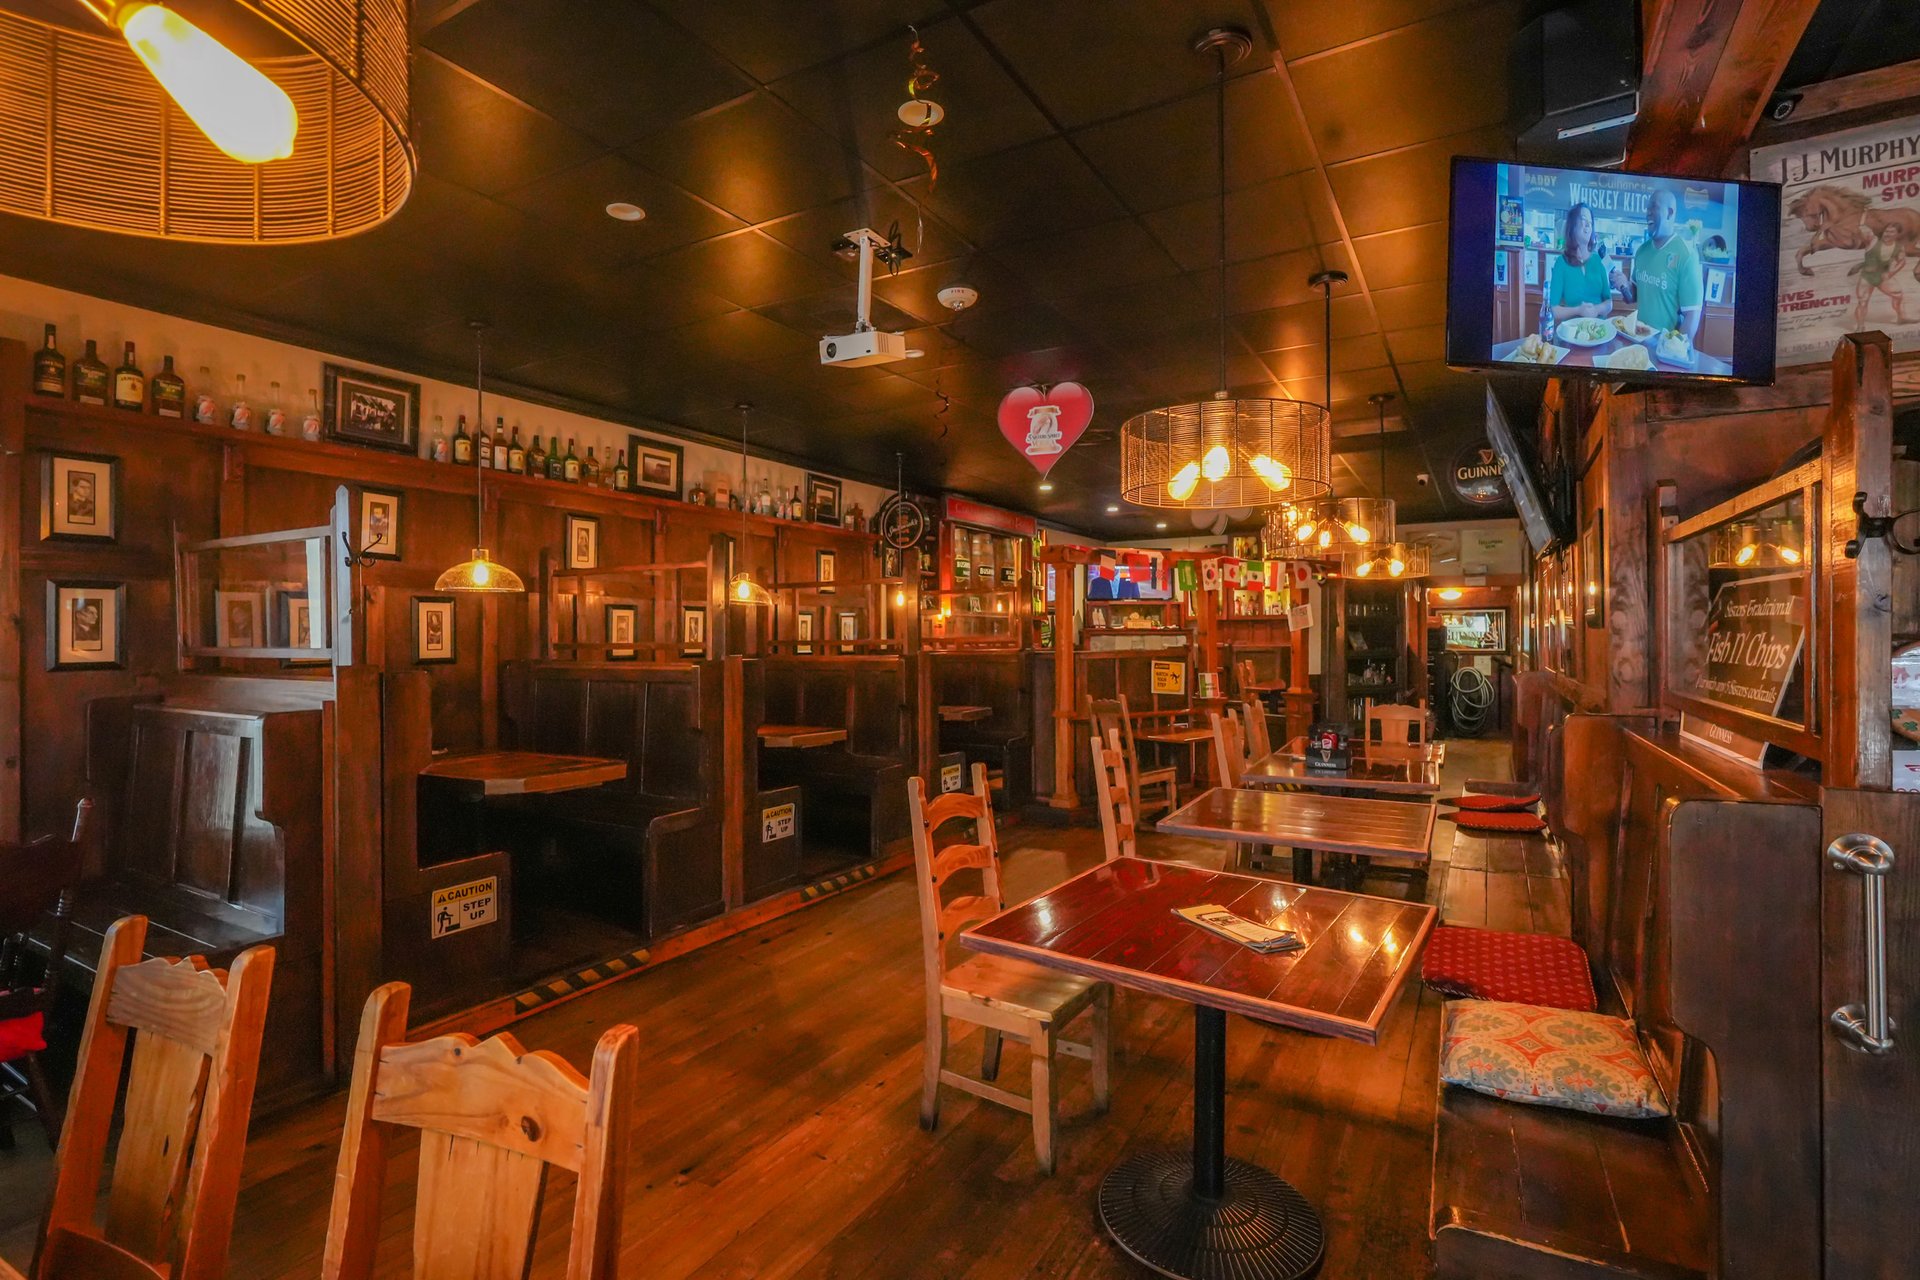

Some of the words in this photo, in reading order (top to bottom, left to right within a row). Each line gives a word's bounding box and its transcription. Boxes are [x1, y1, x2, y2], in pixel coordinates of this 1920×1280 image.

[1820, 134, 1920, 175] MURPHY
[1525, 173, 1557, 187] PADDY
[1569, 182, 1619, 212] WHISKEY
[1623, 192, 1651, 214] KITC
[1881, 182, 1920, 203] STO
[1705, 631, 1731, 664] Fish
[1746, 631, 1791, 680] Chips
[770, 807, 792, 818] CAUTION
[777, 818, 792, 826] STEP
[447, 882, 493, 901] CAUTION
[463, 897, 491, 912] STEP
[470, 909, 485, 921] UP
